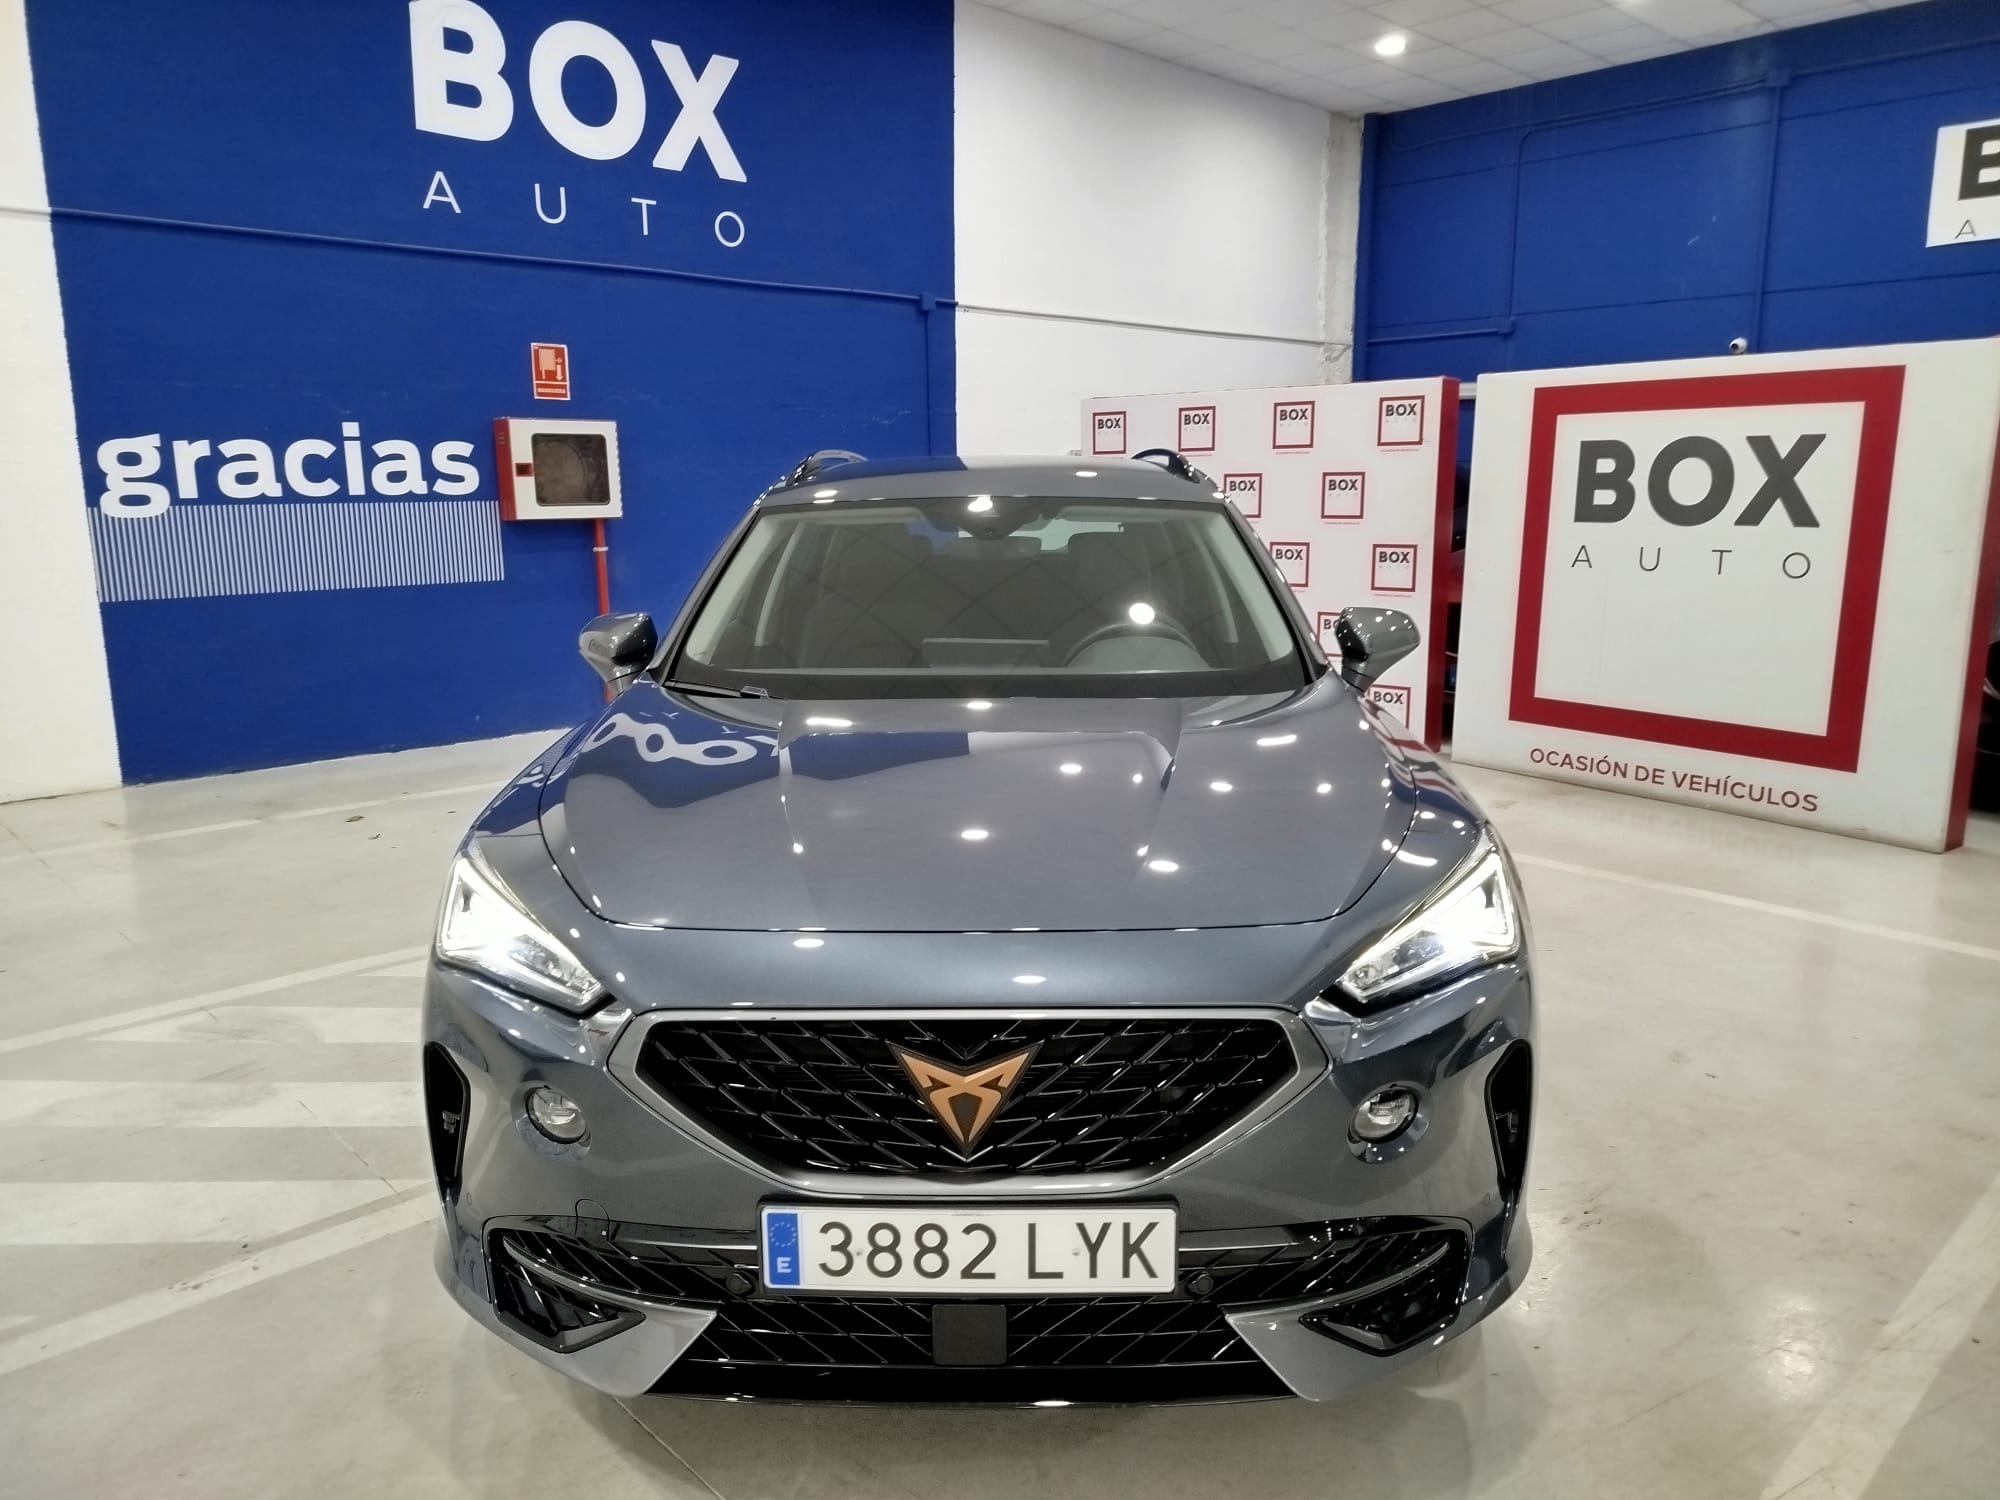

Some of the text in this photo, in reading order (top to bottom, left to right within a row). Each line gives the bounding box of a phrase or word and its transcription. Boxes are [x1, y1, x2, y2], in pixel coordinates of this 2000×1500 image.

[408, 0, 747, 183] BOX
[422, 171, 747, 248] AUTO
[1279, 408, 1309, 421] BOX
[1385, 403, 1417, 416] BOX
[1097, 418, 1121, 429] BOX
[1184, 413, 1210, 425] BOX
[97, 421, 480, 519] gracias
[1229, 480, 1256, 492] BOX
[1328, 479, 1358, 491] BOX
[1574, 433, 1827, 528] BOX
[1275, 548, 1303, 560] BOX
[1379, 551, 1410, 564] BOX
[1571, 545, 1811, 580] AUTO
[1373, 691, 1404, 705] BOX
[1529, 748, 1819, 812] OCASIÓN DE VEHÍCULOS
[776, 1221, 1160, 1280] E 3882 LYK
